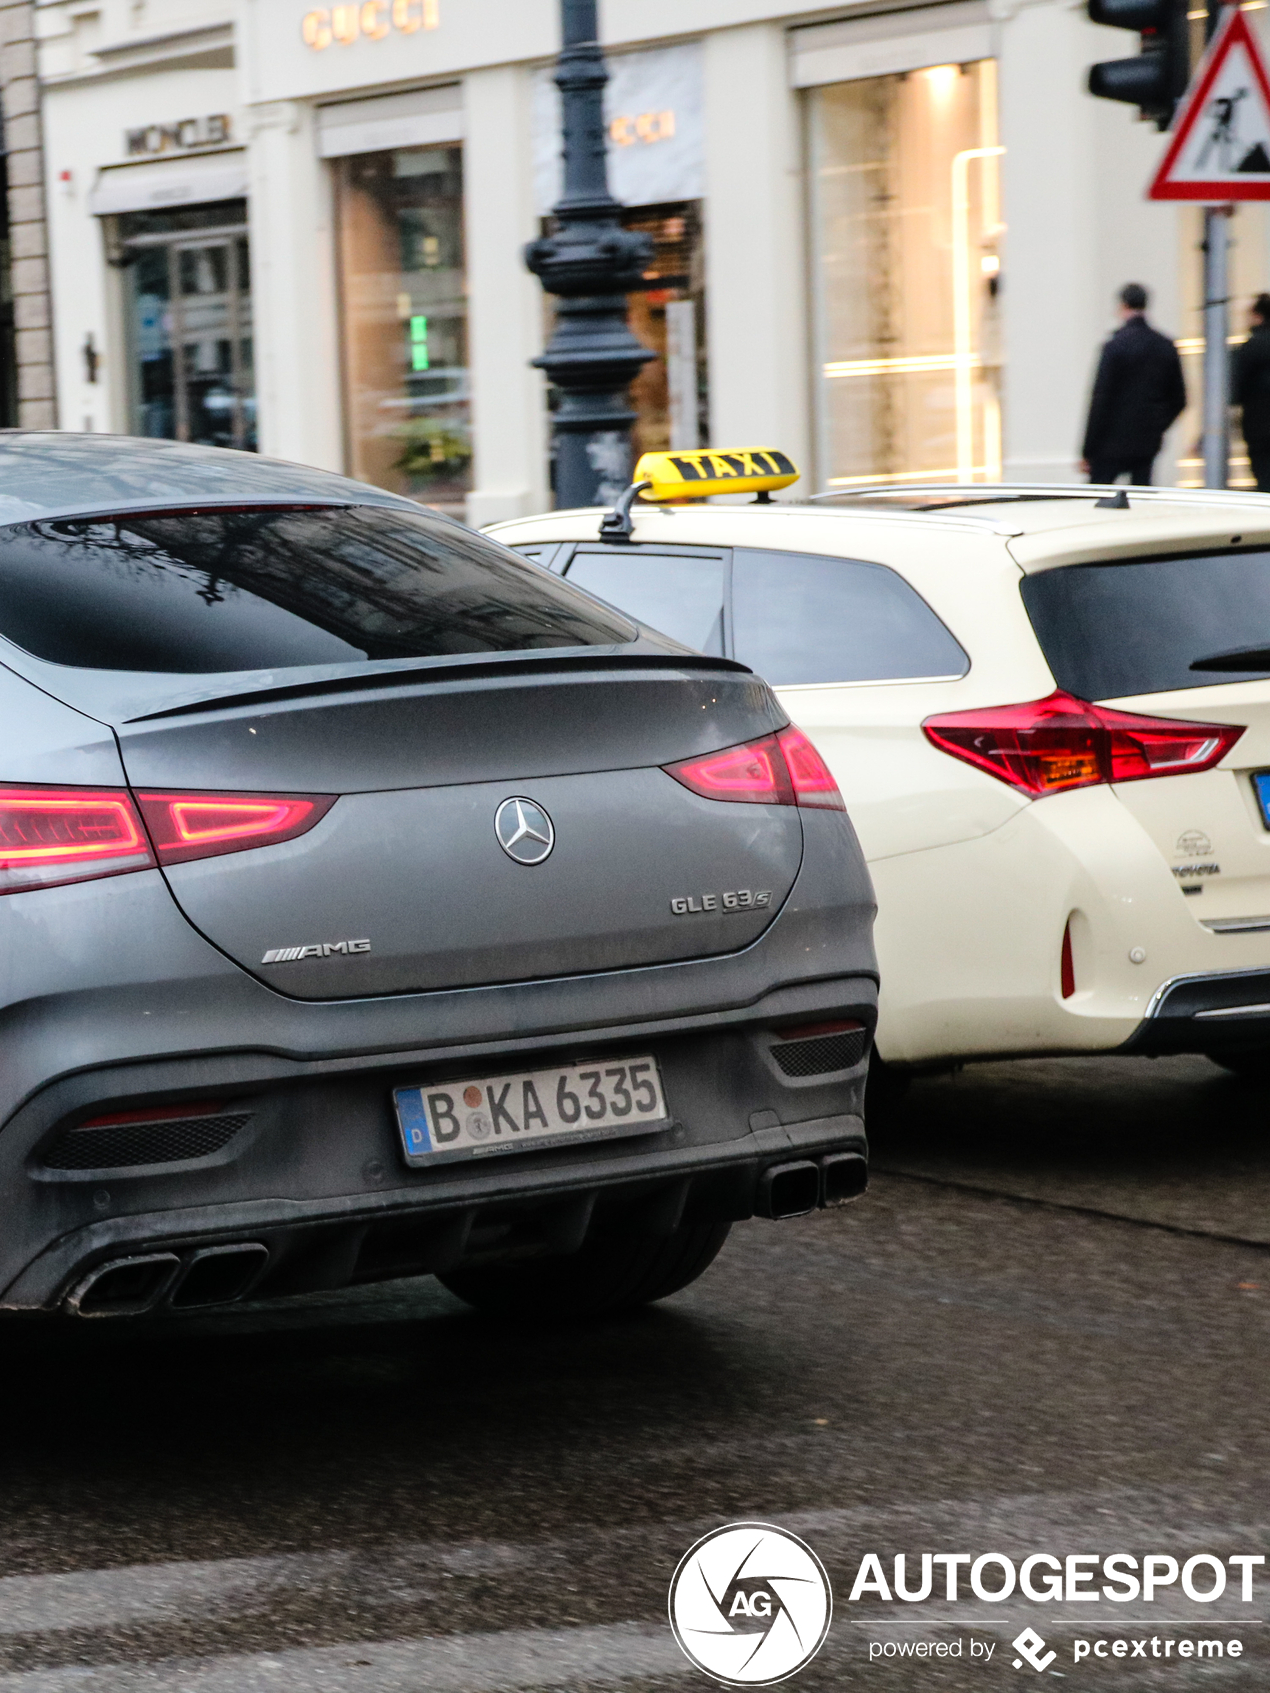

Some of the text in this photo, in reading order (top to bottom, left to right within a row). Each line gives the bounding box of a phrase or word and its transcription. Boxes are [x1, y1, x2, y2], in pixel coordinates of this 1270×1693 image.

[302, 0, 439, 51] GUCCI
[610, 109, 675, 147] CCI
[681, 452, 780, 479] TAXI
[1171, 863, 1221, 878] TOYOTA
[671, 894, 717, 914] GLE
[427, 1063, 657, 1144] B KA 6335
[411, 1128, 423, 1144] D
